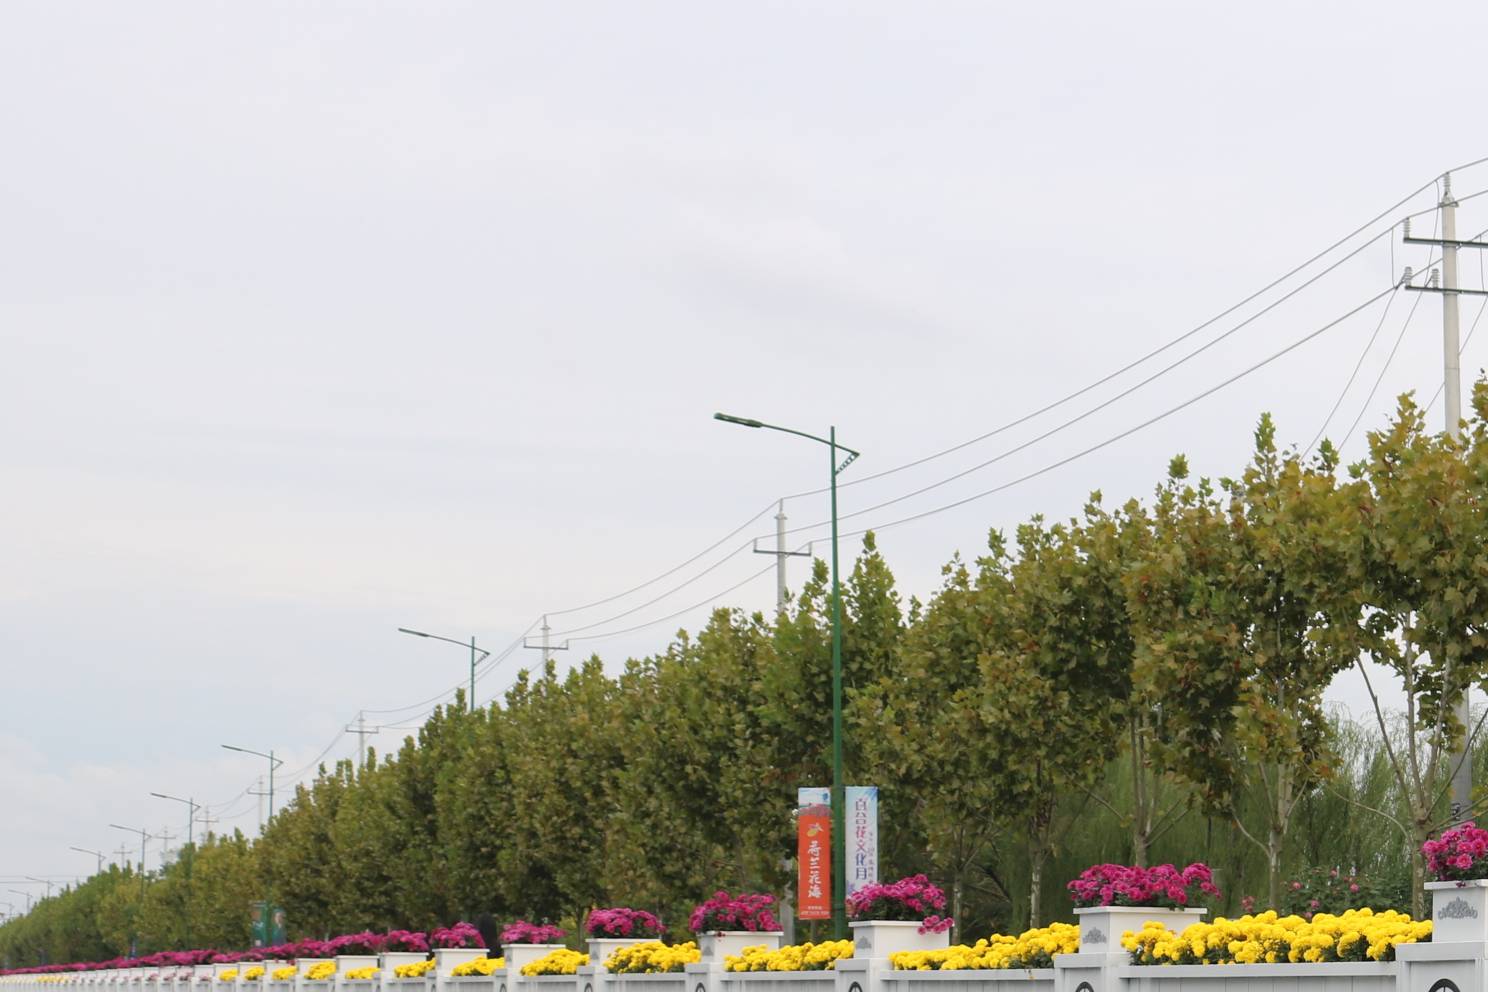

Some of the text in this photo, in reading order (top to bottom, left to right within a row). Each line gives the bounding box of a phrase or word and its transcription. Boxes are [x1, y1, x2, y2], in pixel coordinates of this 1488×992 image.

[855, 798, 868, 880] 百合花文化月
